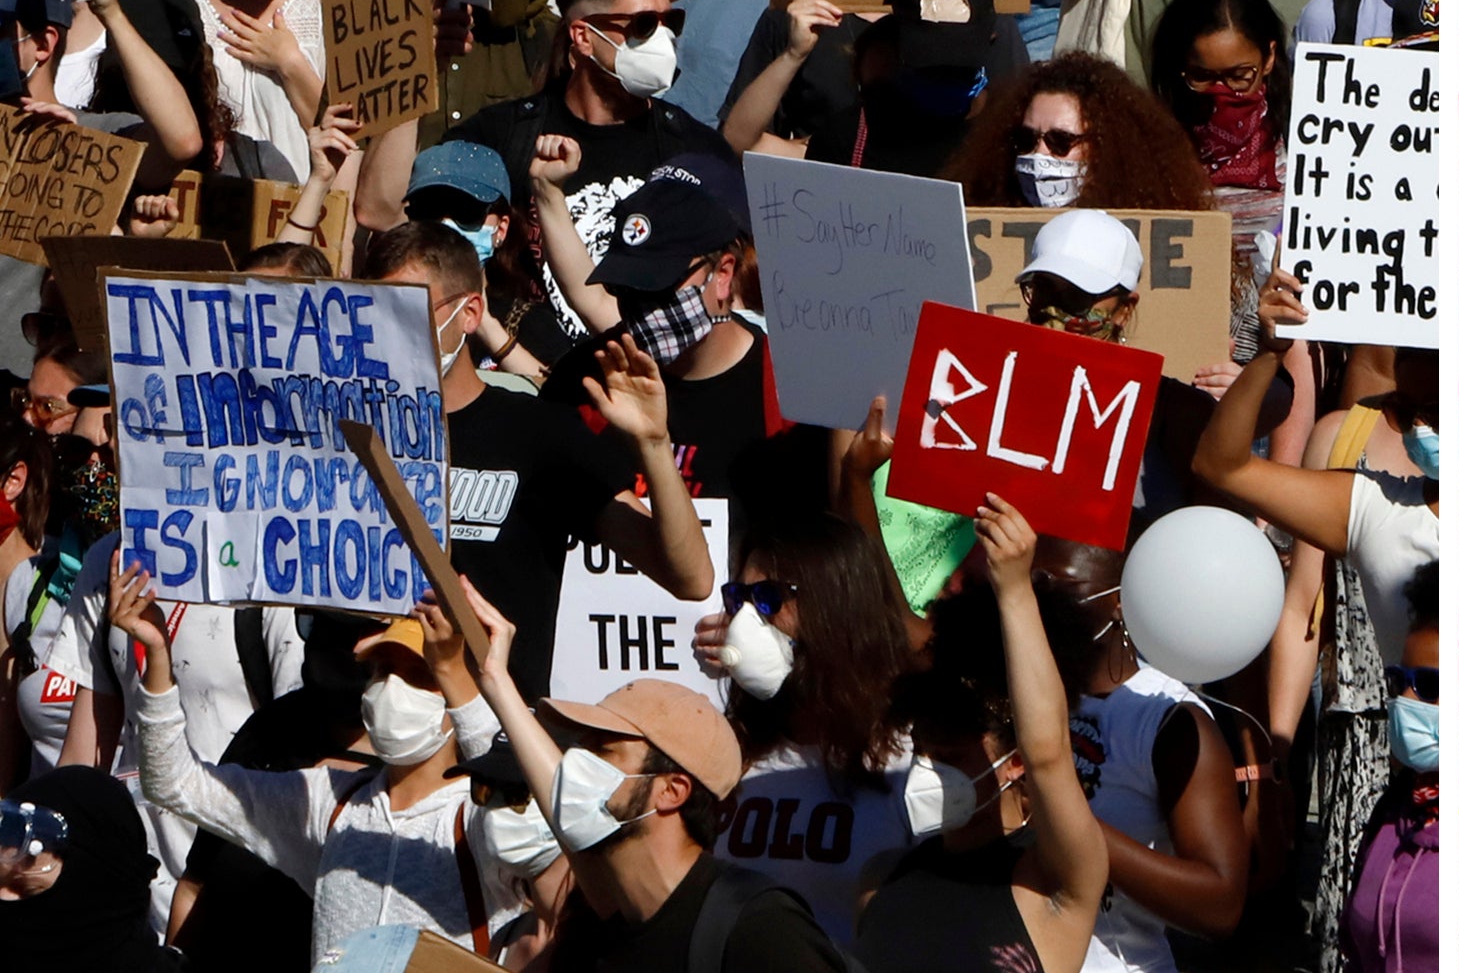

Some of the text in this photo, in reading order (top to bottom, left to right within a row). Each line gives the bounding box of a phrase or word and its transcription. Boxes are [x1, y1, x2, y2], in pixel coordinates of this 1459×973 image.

[334, 29, 418, 94] LIVES
[1304, 51, 1381, 109] The
[348, 73, 430, 126] ATTER
[1296, 113, 1376, 158] cry
[72, 183, 106, 219] TO
[1293, 153, 1330, 199] It
[1345, 161, 1374, 202] is
[1287, 205, 1406, 277] living
[1370, 262, 1438, 321] the
[107, 284, 390, 381] IN THE AGE
[918, 346, 1142, 492] BLM
[123, 508, 199, 588] IS
[218, 541, 241, 569] a
[588, 614, 680, 671] THE
